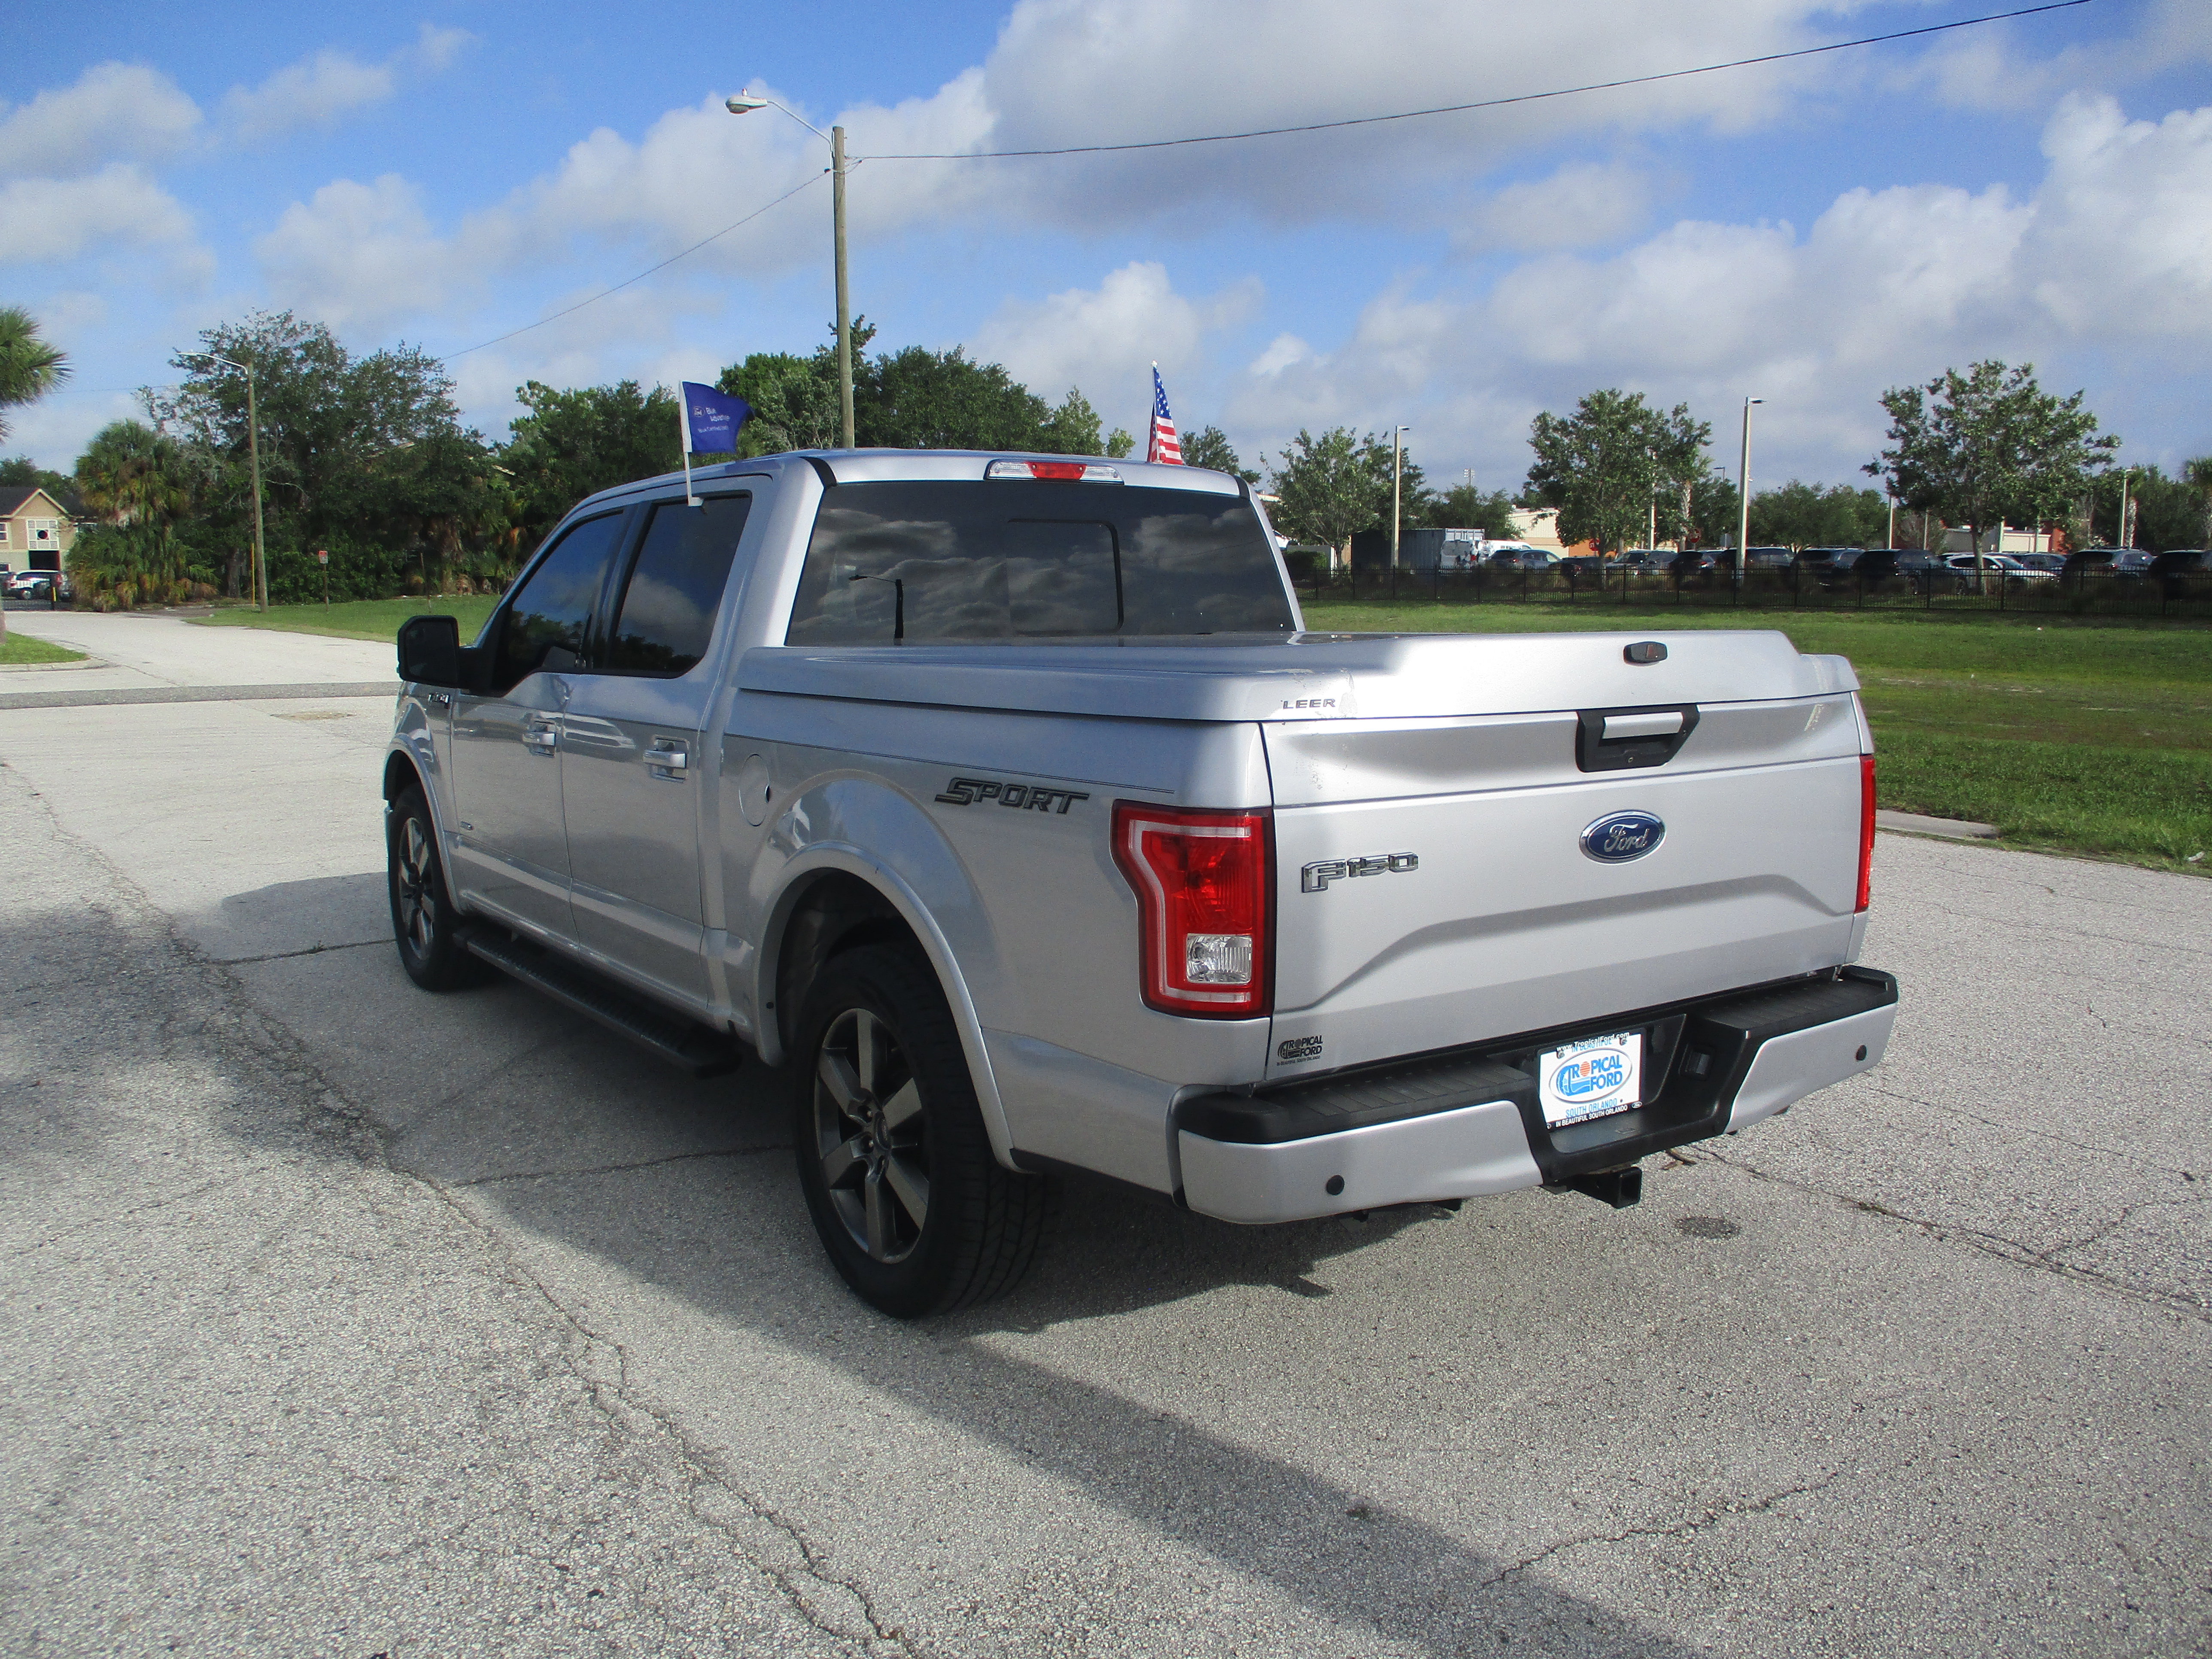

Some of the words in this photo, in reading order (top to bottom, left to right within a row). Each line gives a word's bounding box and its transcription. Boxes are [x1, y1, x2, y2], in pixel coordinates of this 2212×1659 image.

[1283, 699, 1335, 709] LEER
[935, 777, 1089, 814] SPORT
[1604, 823, 1650, 852] Ford
[1277, 1035, 1323, 1054] TROPICAL
[1300, 1045, 1322, 1057] FORD
[1556, 1032, 1630, 1051] www.TropicalFord.com
[1556, 1054, 1623, 1088] TROPICAL
[1591, 1070, 1623, 1091] FORD
[1562, 1114, 1588, 1127] BEAUTIFUL
[1589, 1110, 1605, 1120] SOUTH
[1605, 1104, 1628, 1115] ORLANDO
[1565, 1106, 1587, 1118] SOUTH
[1589, 1098, 1617, 1113] ORLANDO
